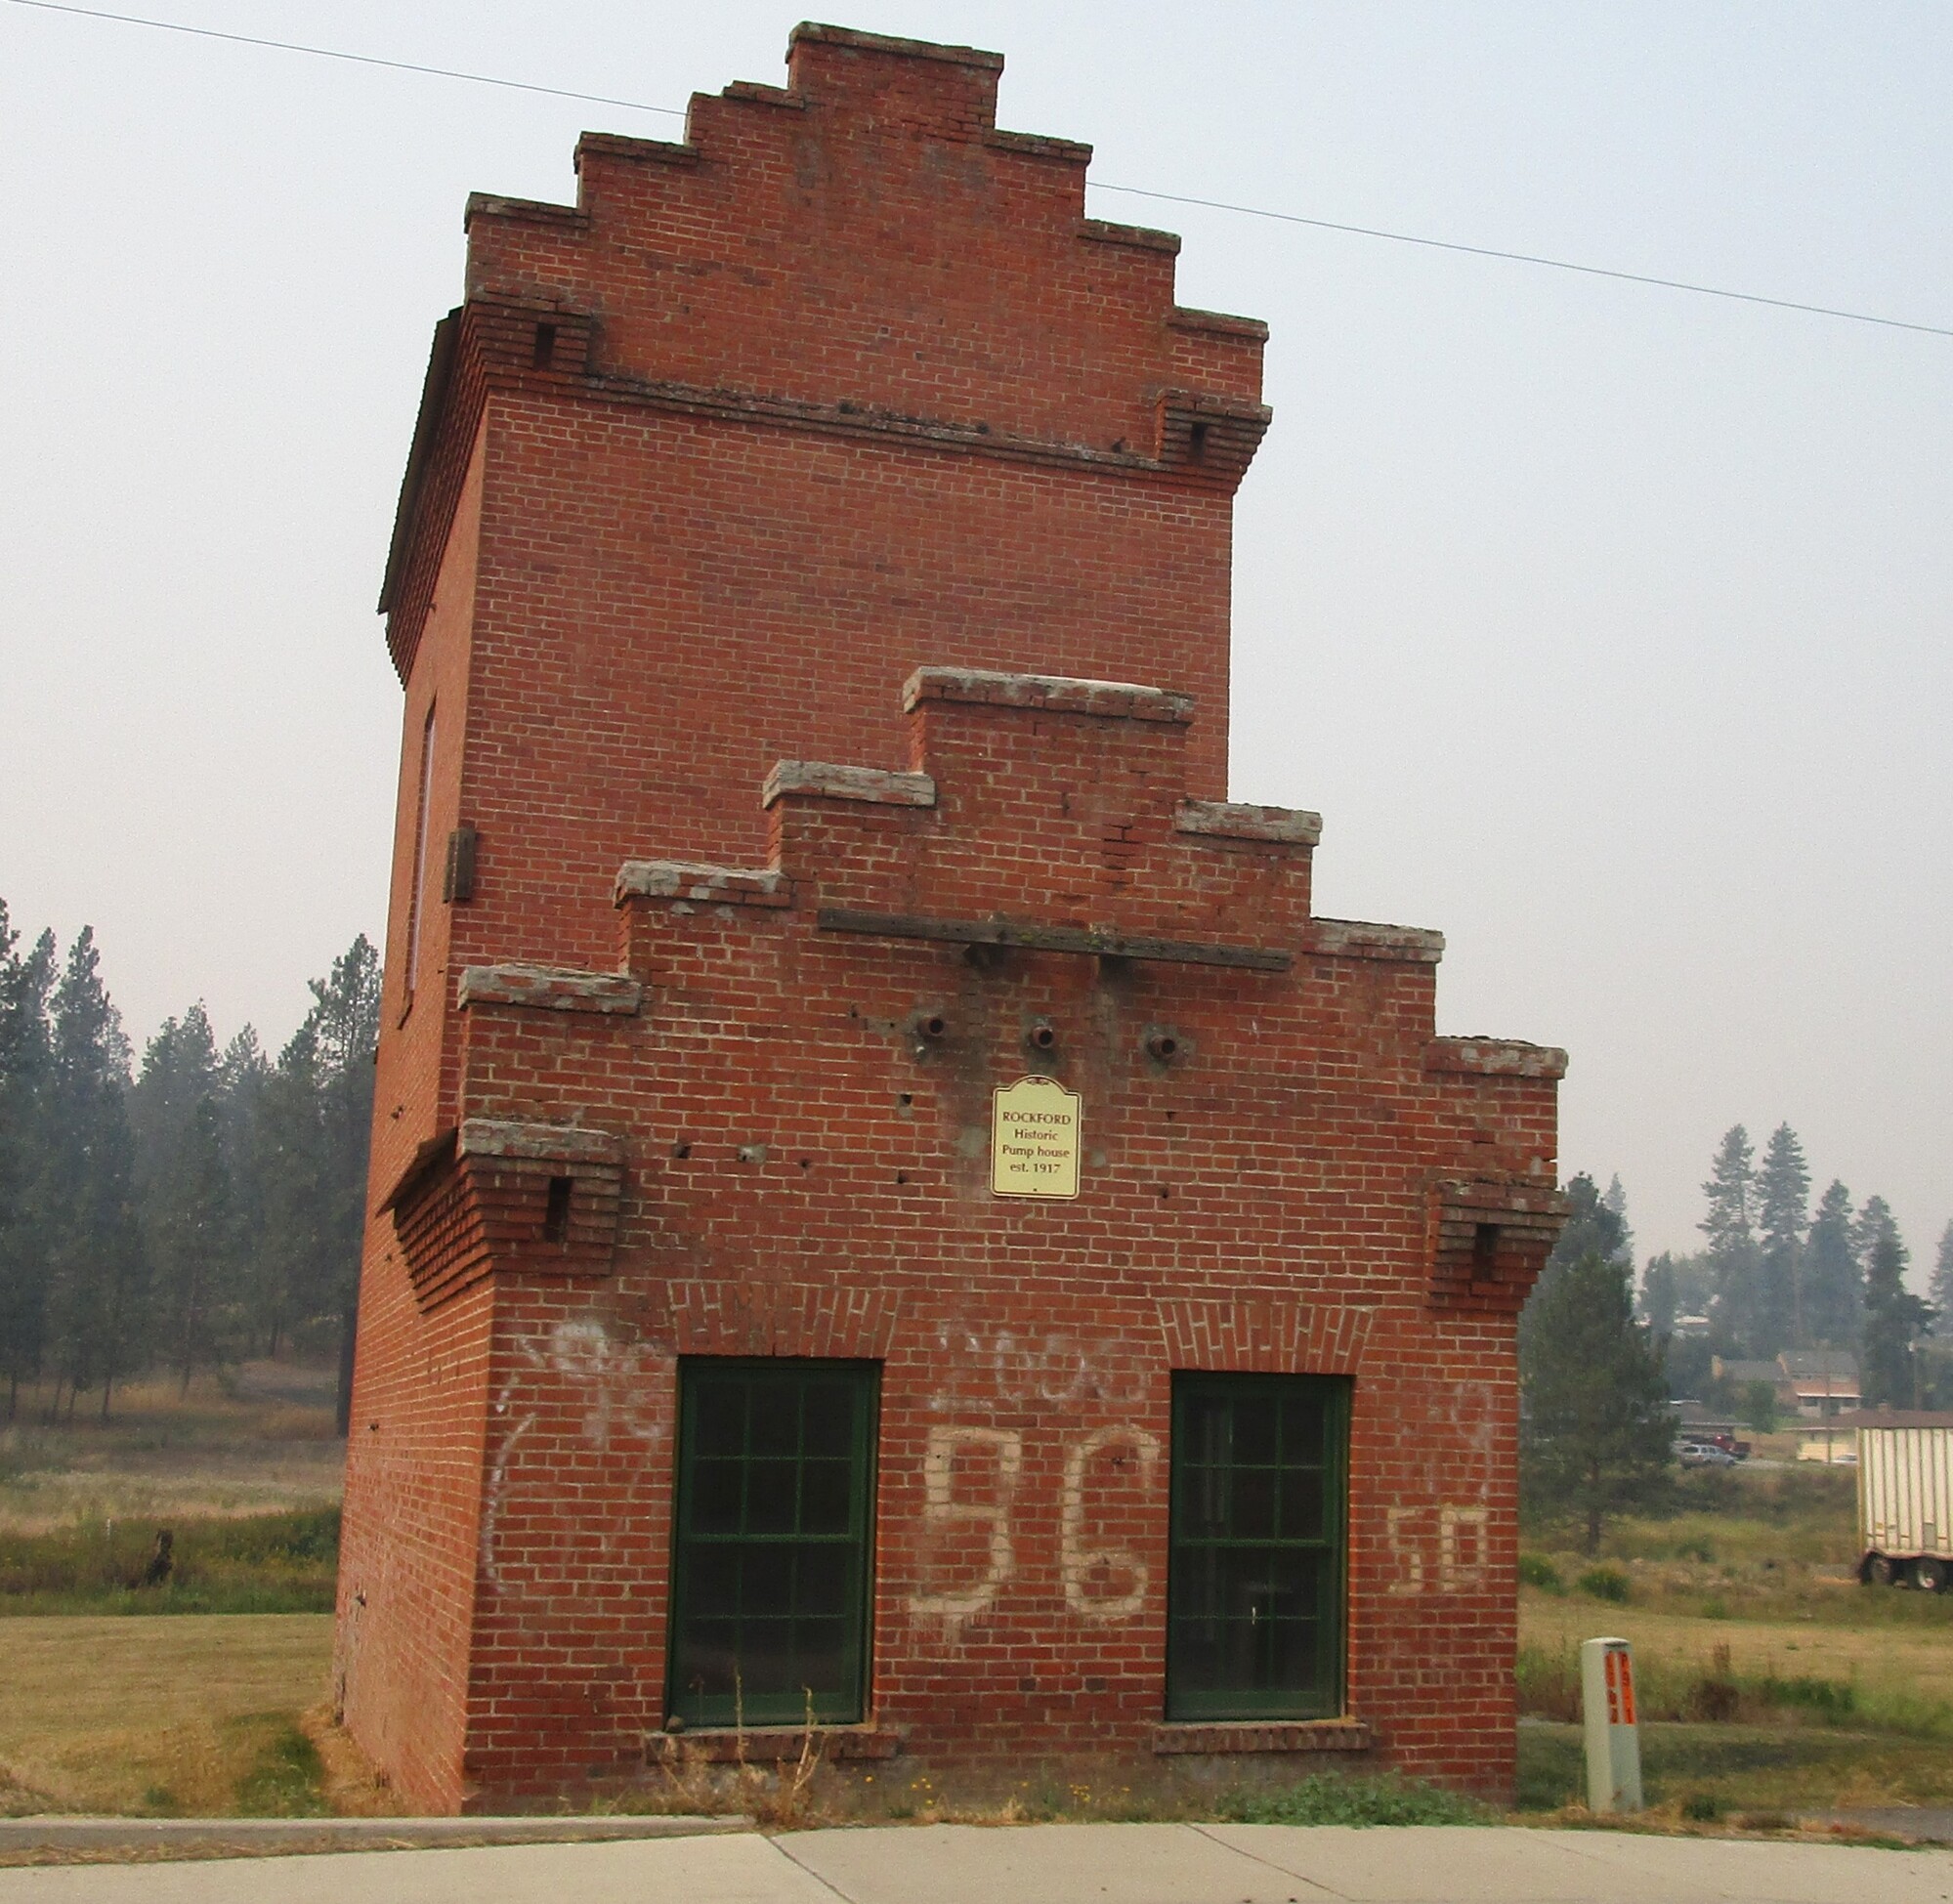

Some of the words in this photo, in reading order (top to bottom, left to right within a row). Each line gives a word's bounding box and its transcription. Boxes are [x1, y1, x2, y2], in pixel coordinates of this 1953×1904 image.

[1002, 1112, 1071, 1125] ROCKFORD
[1014, 1128, 1059, 1141] Historic
[1002, 1144, 1034, 1159] Pump
[1038, 1146, 1070, 1158] house
[1010, 1163, 1029, 1172] est.
[1034, 1164, 1061, 1173] 1917
